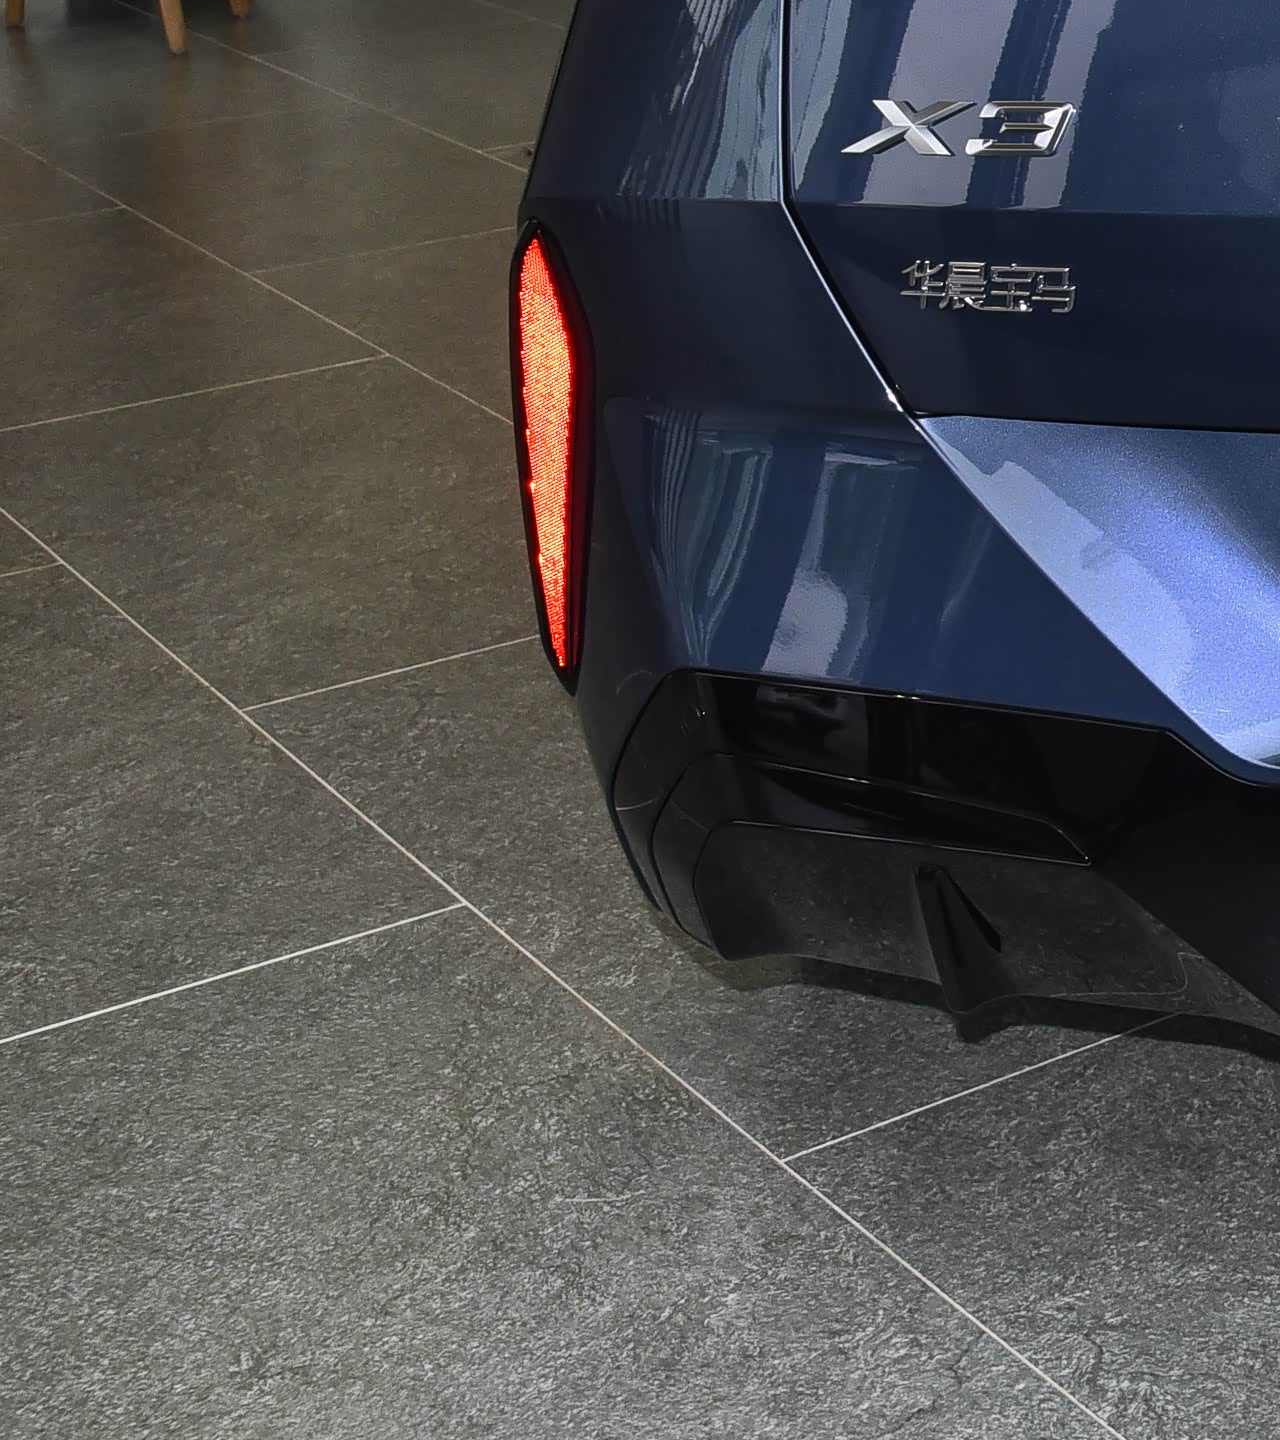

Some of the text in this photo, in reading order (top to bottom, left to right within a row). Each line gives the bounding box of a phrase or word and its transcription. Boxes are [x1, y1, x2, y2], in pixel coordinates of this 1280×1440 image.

[840, 100, 1077, 156] X3
[900, 259, 1076, 313] 华晨宝马
